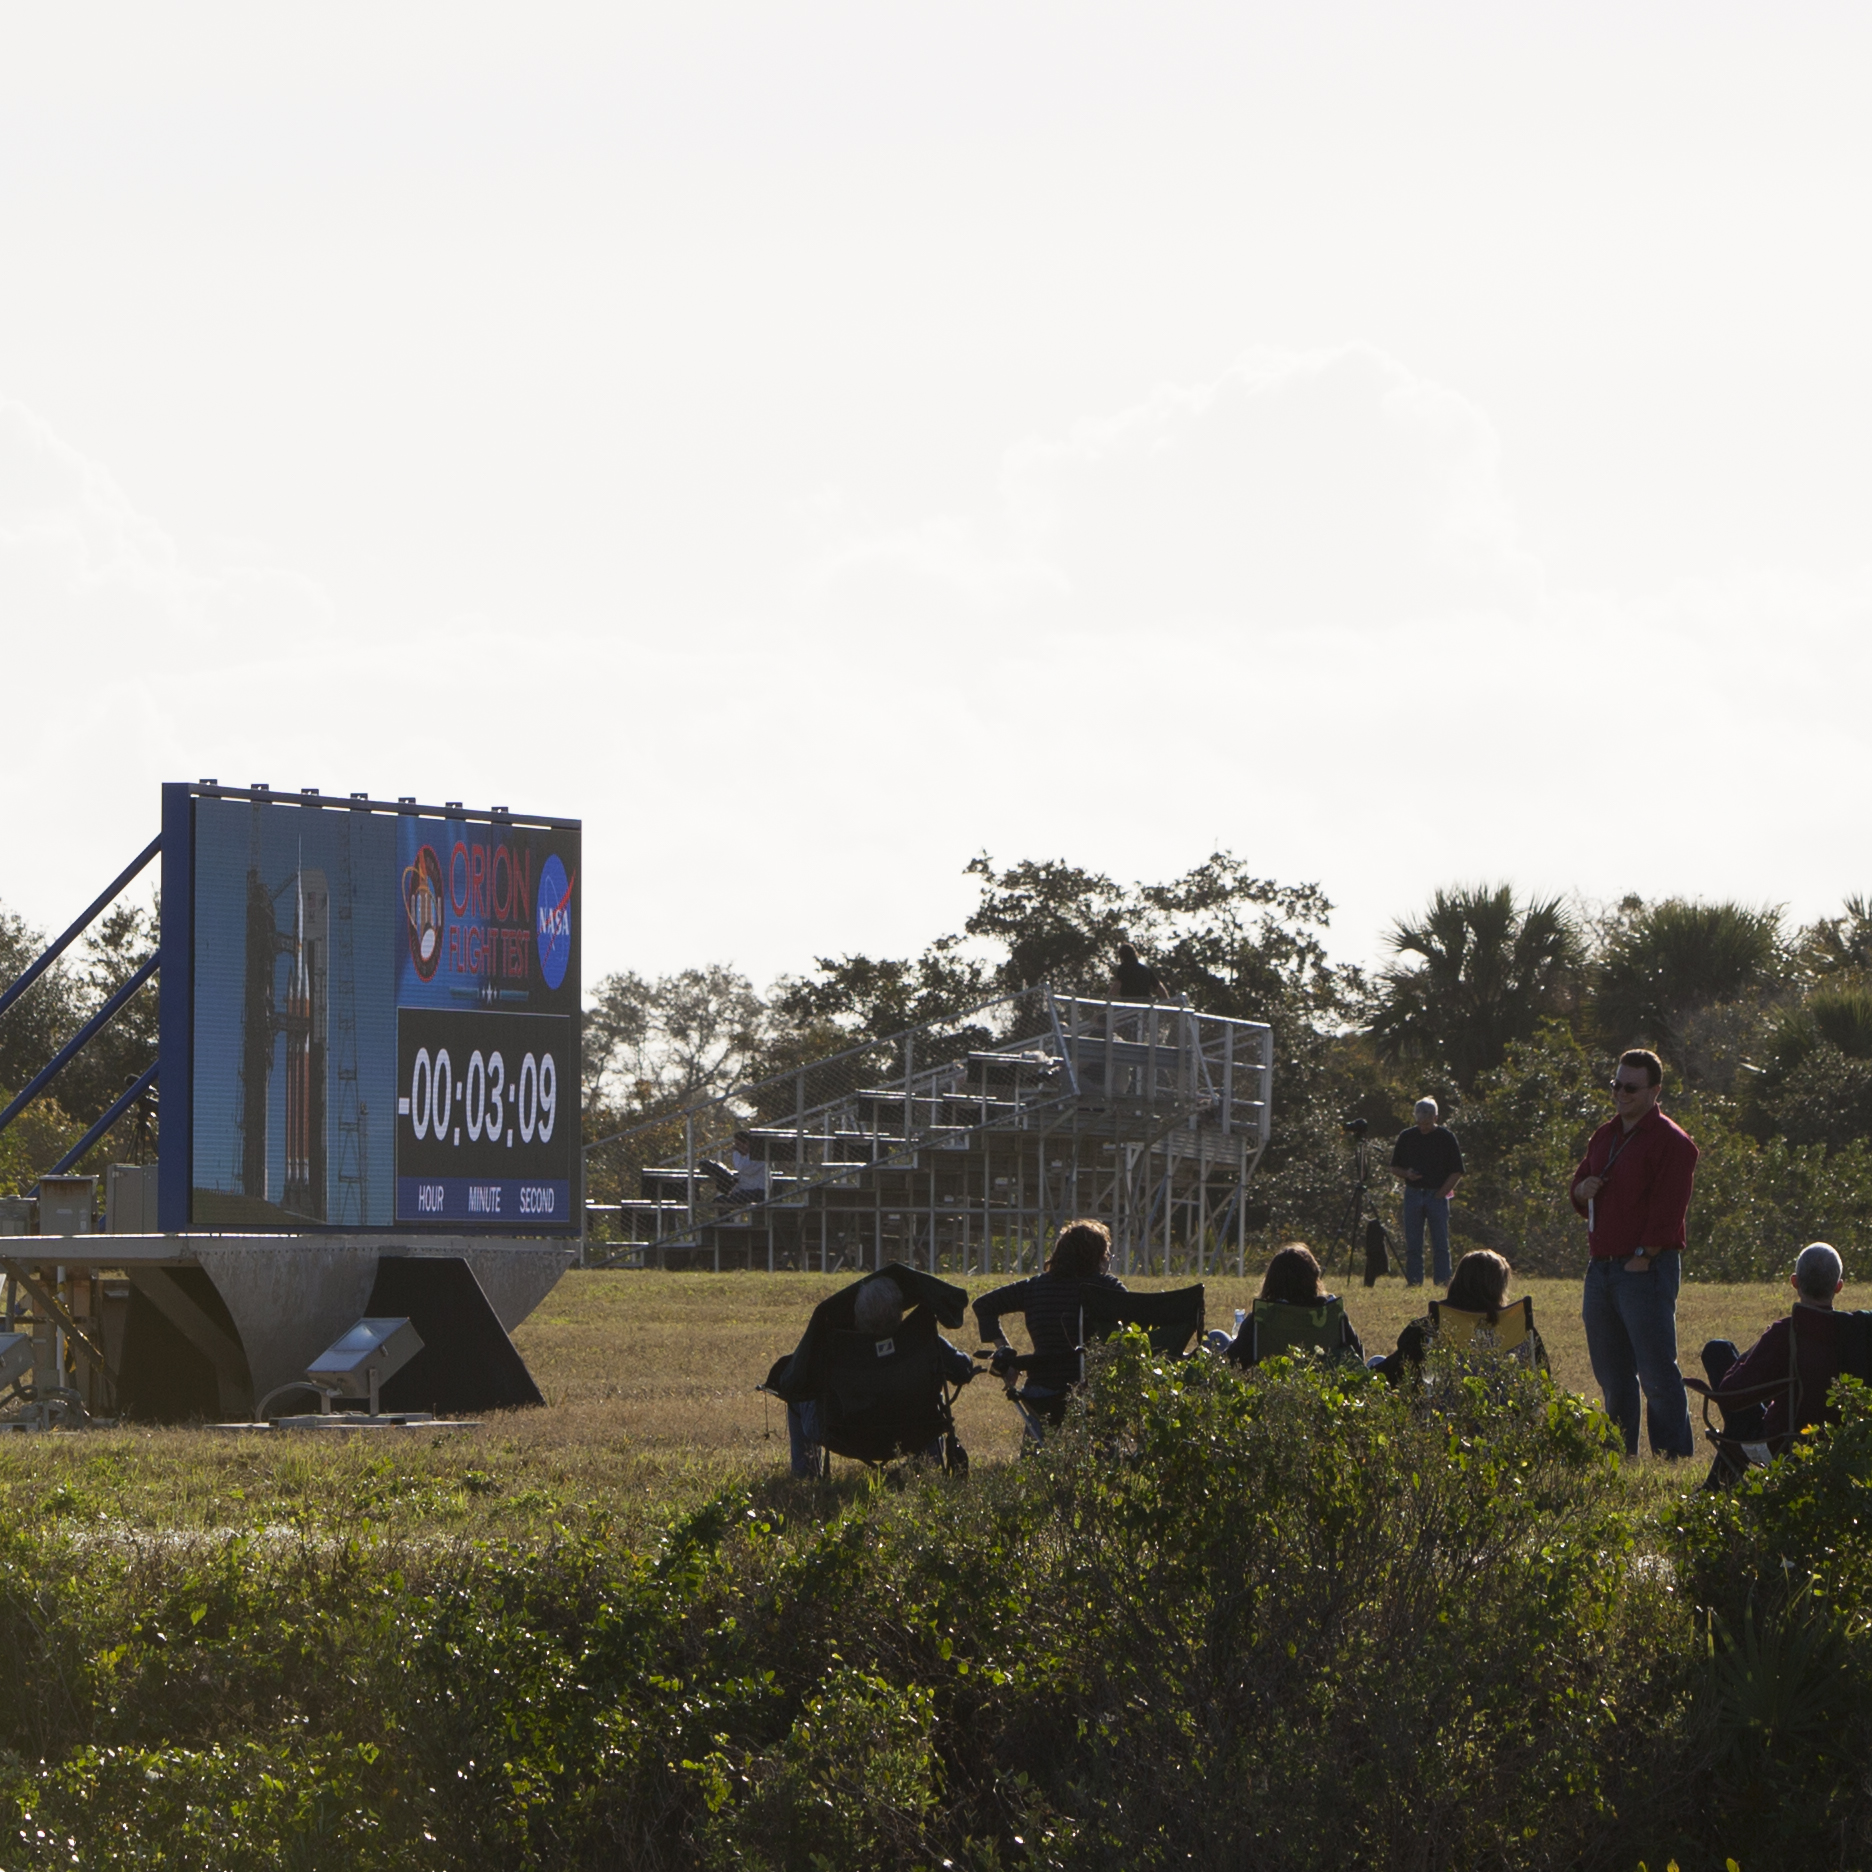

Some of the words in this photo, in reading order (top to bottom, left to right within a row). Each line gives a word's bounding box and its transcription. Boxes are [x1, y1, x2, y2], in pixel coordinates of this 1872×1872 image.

[449, 840, 531, 922] ORION
[539, 907, 570, 936] NASA
[449, 926, 499, 976] FLIGHT
[501, 929, 531, 978] TEST
[418, 1185, 444, 1212] HOUR
[468, 1186, 501, 1212] MINUTE
[519, 1187, 554, 1213] SECOND
